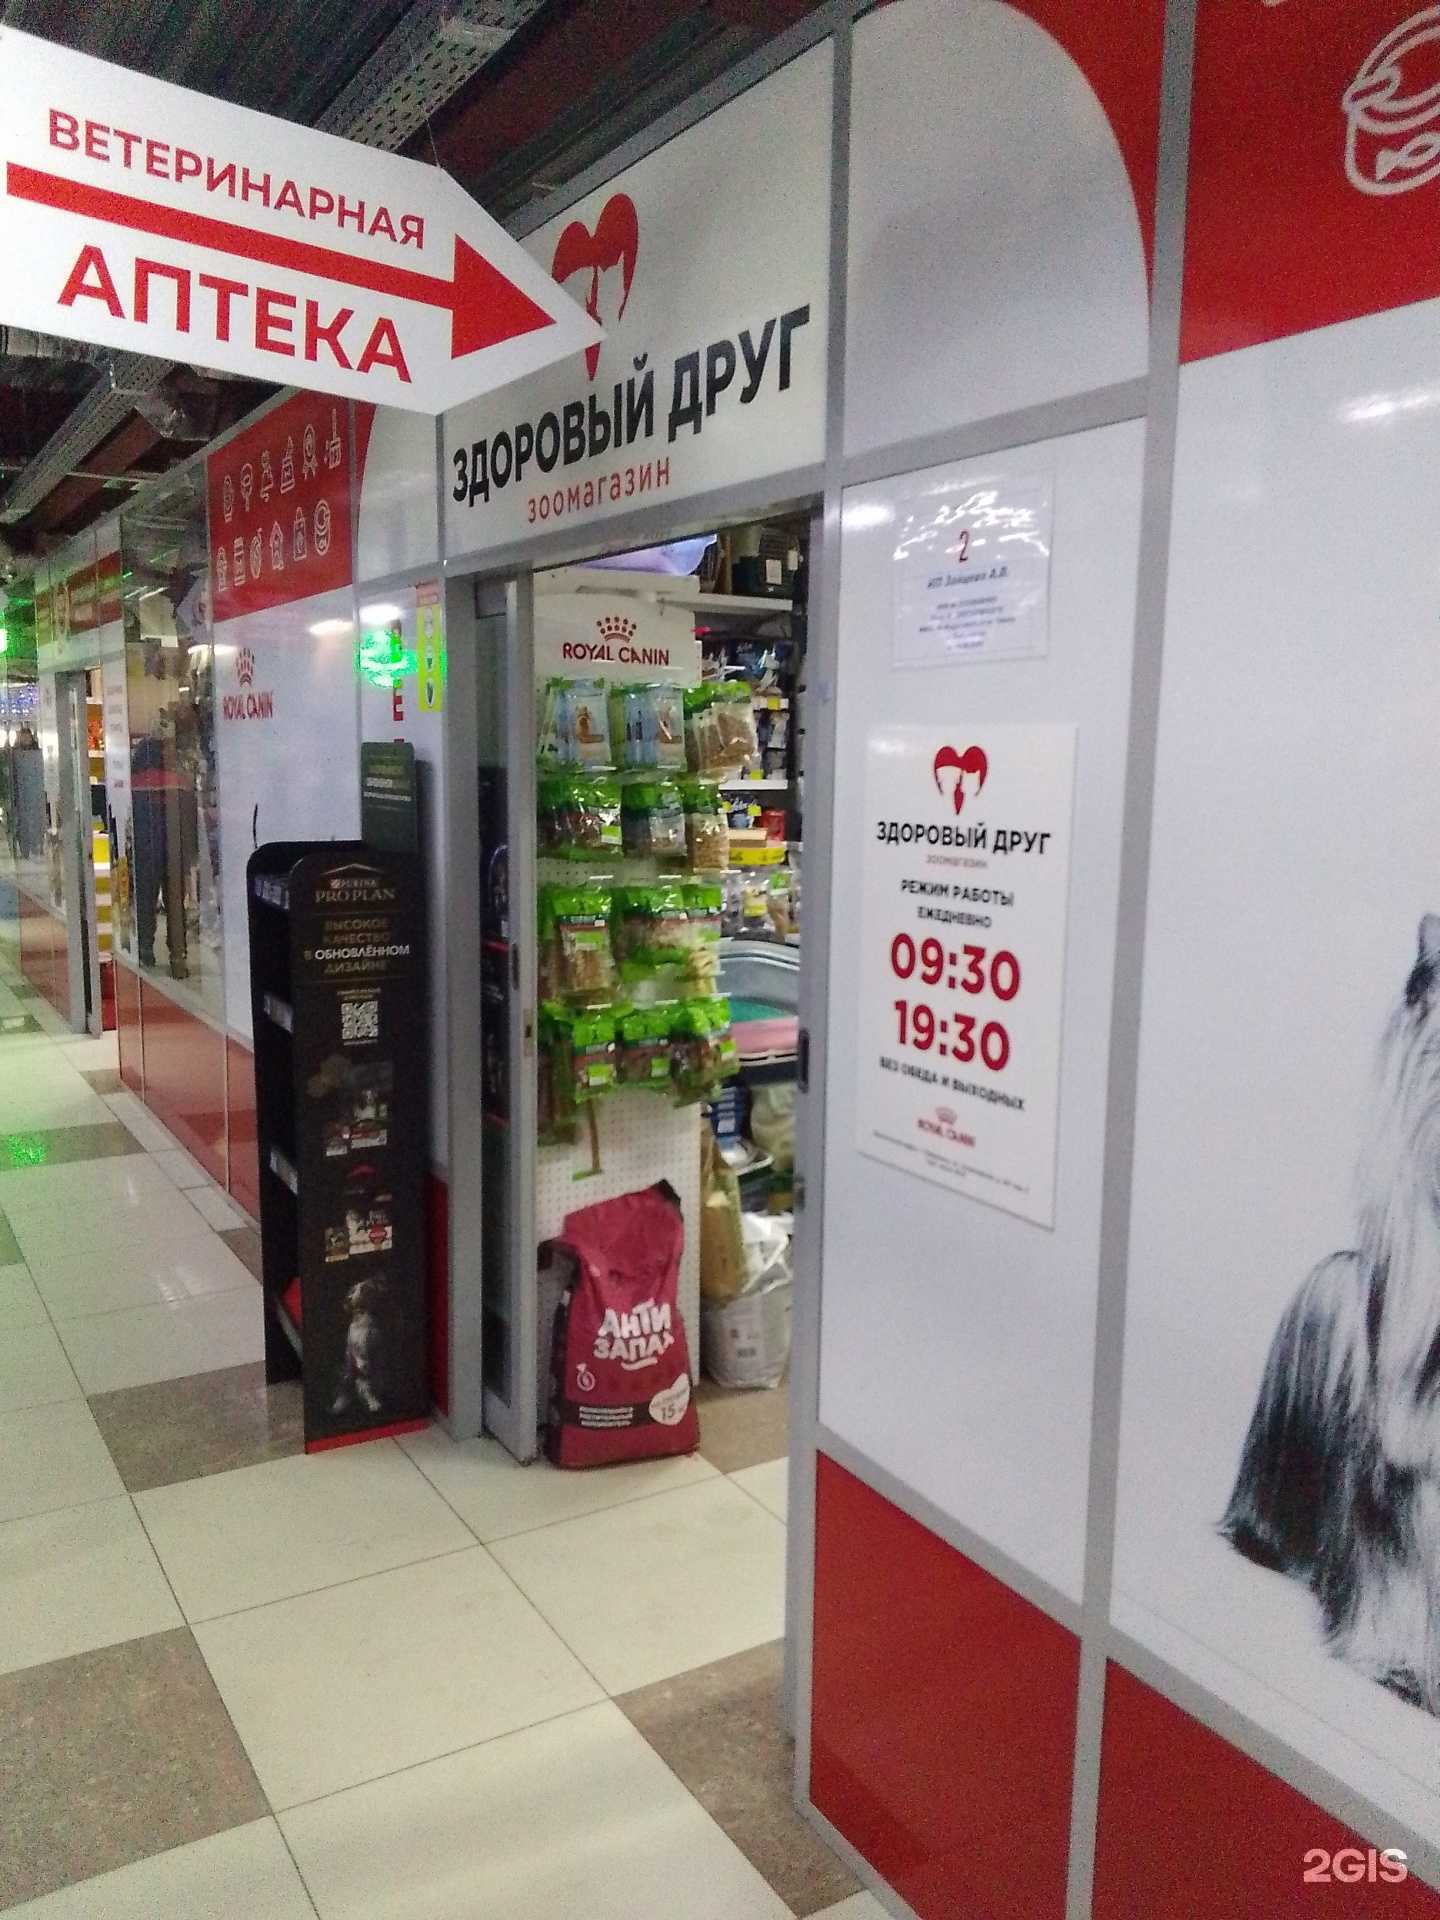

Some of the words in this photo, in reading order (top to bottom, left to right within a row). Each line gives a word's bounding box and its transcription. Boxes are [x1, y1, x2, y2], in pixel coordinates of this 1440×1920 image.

[49, 107, 425, 250] ВЕТЕРИНАРНАЯ
[57, 244, 413, 384] АПТЕКА
[452, 353, 654, 508] ЗДОРОВЫЙ
[667, 303, 811, 443] ДРУГ
[527, 456, 670, 524] зоомагазин
[562, 642, 614, 661] ROYAL
[618, 646, 670, 667] CANIN
[876, 821, 987, 849] ЗДОРОВЫЙ
[992, 829, 1052, 855] ДРУГ
[901, 879, 949, 898] РЕЖИМ
[953, 885, 1015, 907] РАБОТЫ
[917, 905, 992, 928] ЕЖЕДНЕВНО
[314, 943, 410, 960] ОБНОВЛЁННОМ
[891, 932, 1020, 1001] 09:30
[894, 1000, 1010, 1071] 19:30
[879, 1056, 899, 1072] БЕЗ
[901, 1063, 938, 1084] ОБЕДА
[952, 1077, 1025, 1111] ВЫХОДНЫХ
[598, 1298, 671, 1339] АНТИ
[593, 1332, 675, 1362] ЗАПАХ
